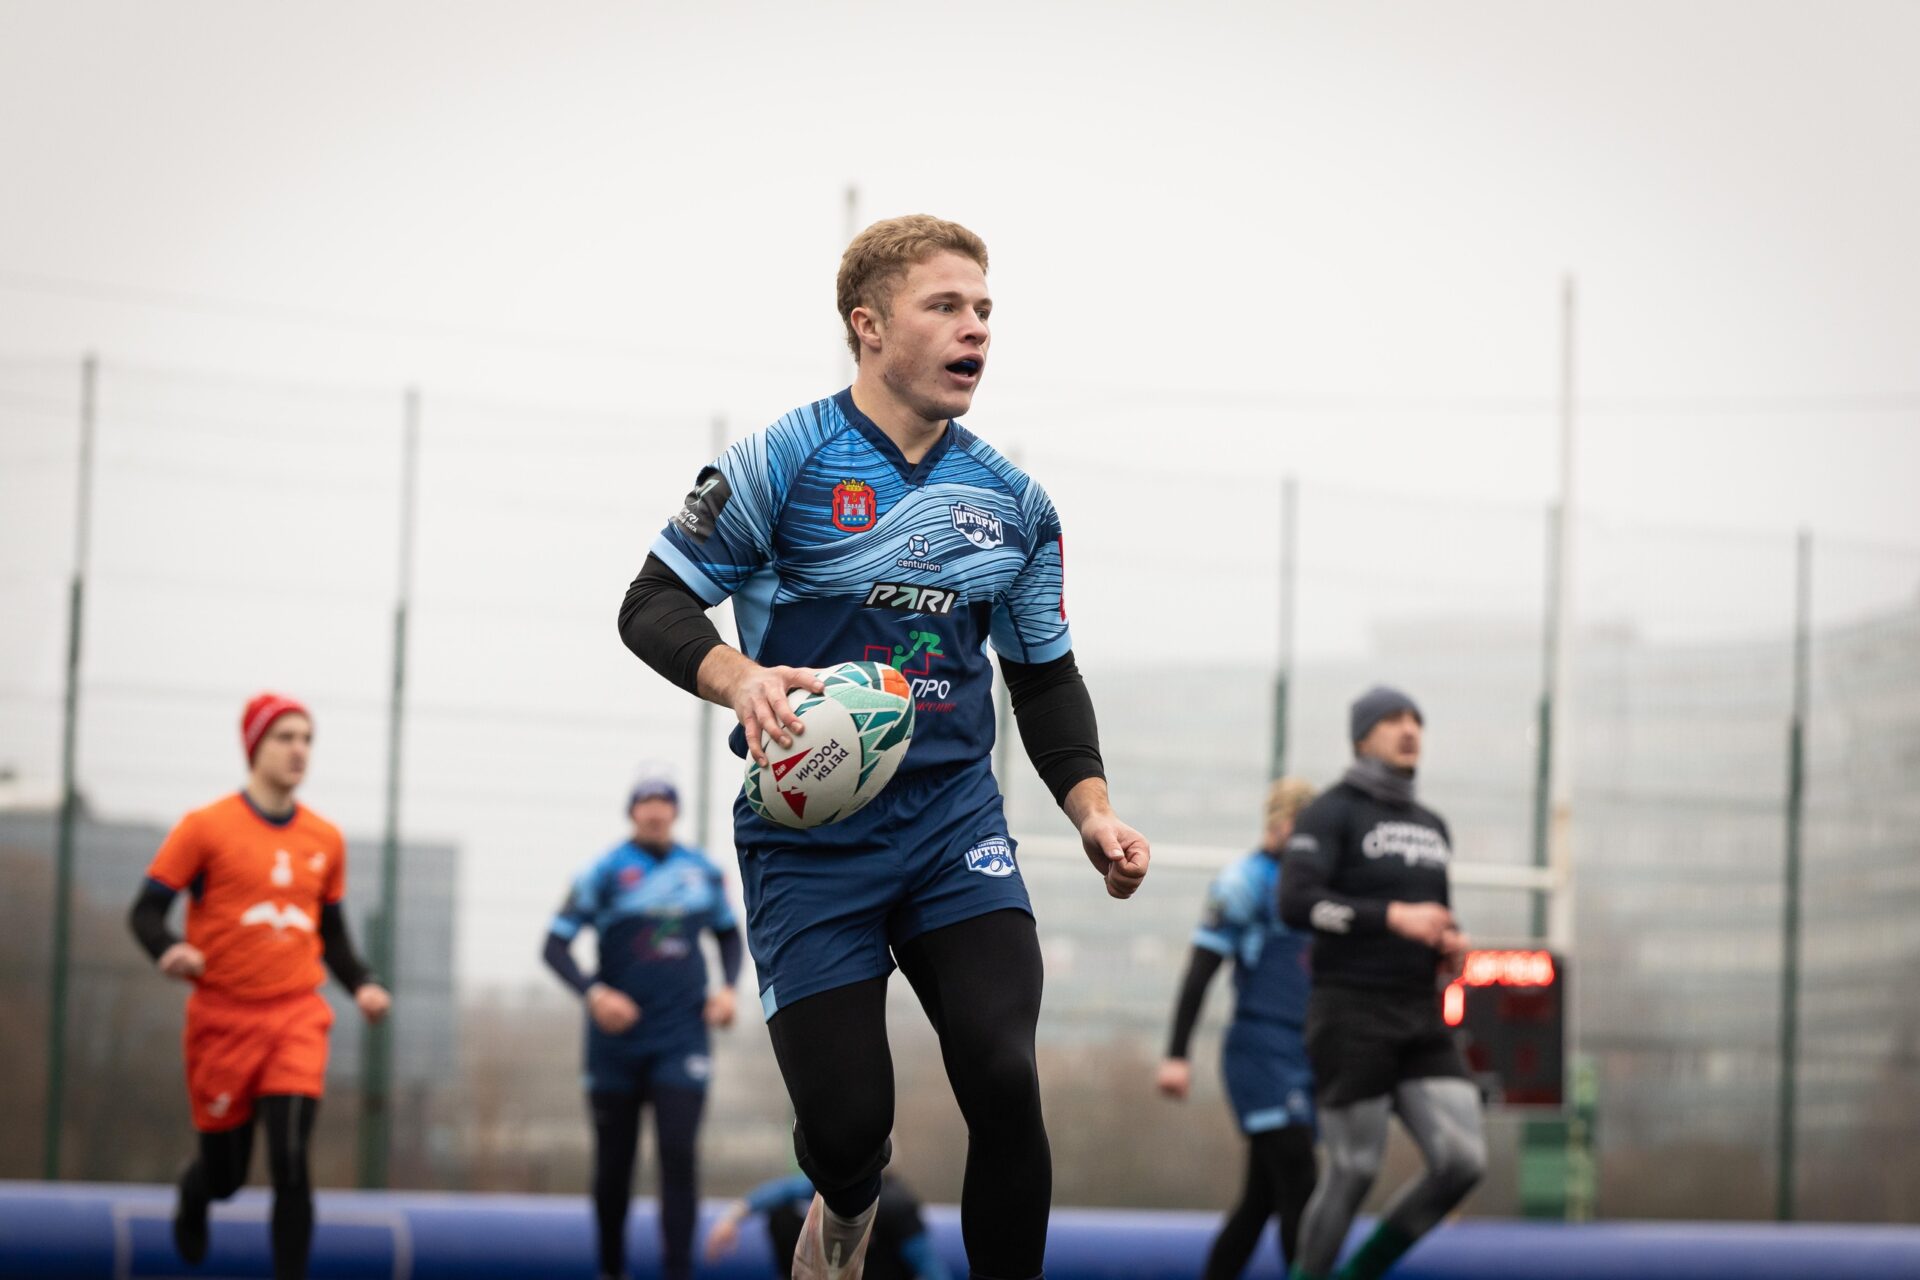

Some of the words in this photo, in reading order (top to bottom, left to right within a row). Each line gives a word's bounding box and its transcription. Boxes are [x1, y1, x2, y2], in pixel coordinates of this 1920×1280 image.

[954, 509, 1000, 538] ШТОРМ
[897, 559, 941, 571] centurion
[865, 584, 955, 613] PARI
[795, 738, 840, 781] РОССИИ
[814, 748, 850, 781] РЕГБИ
